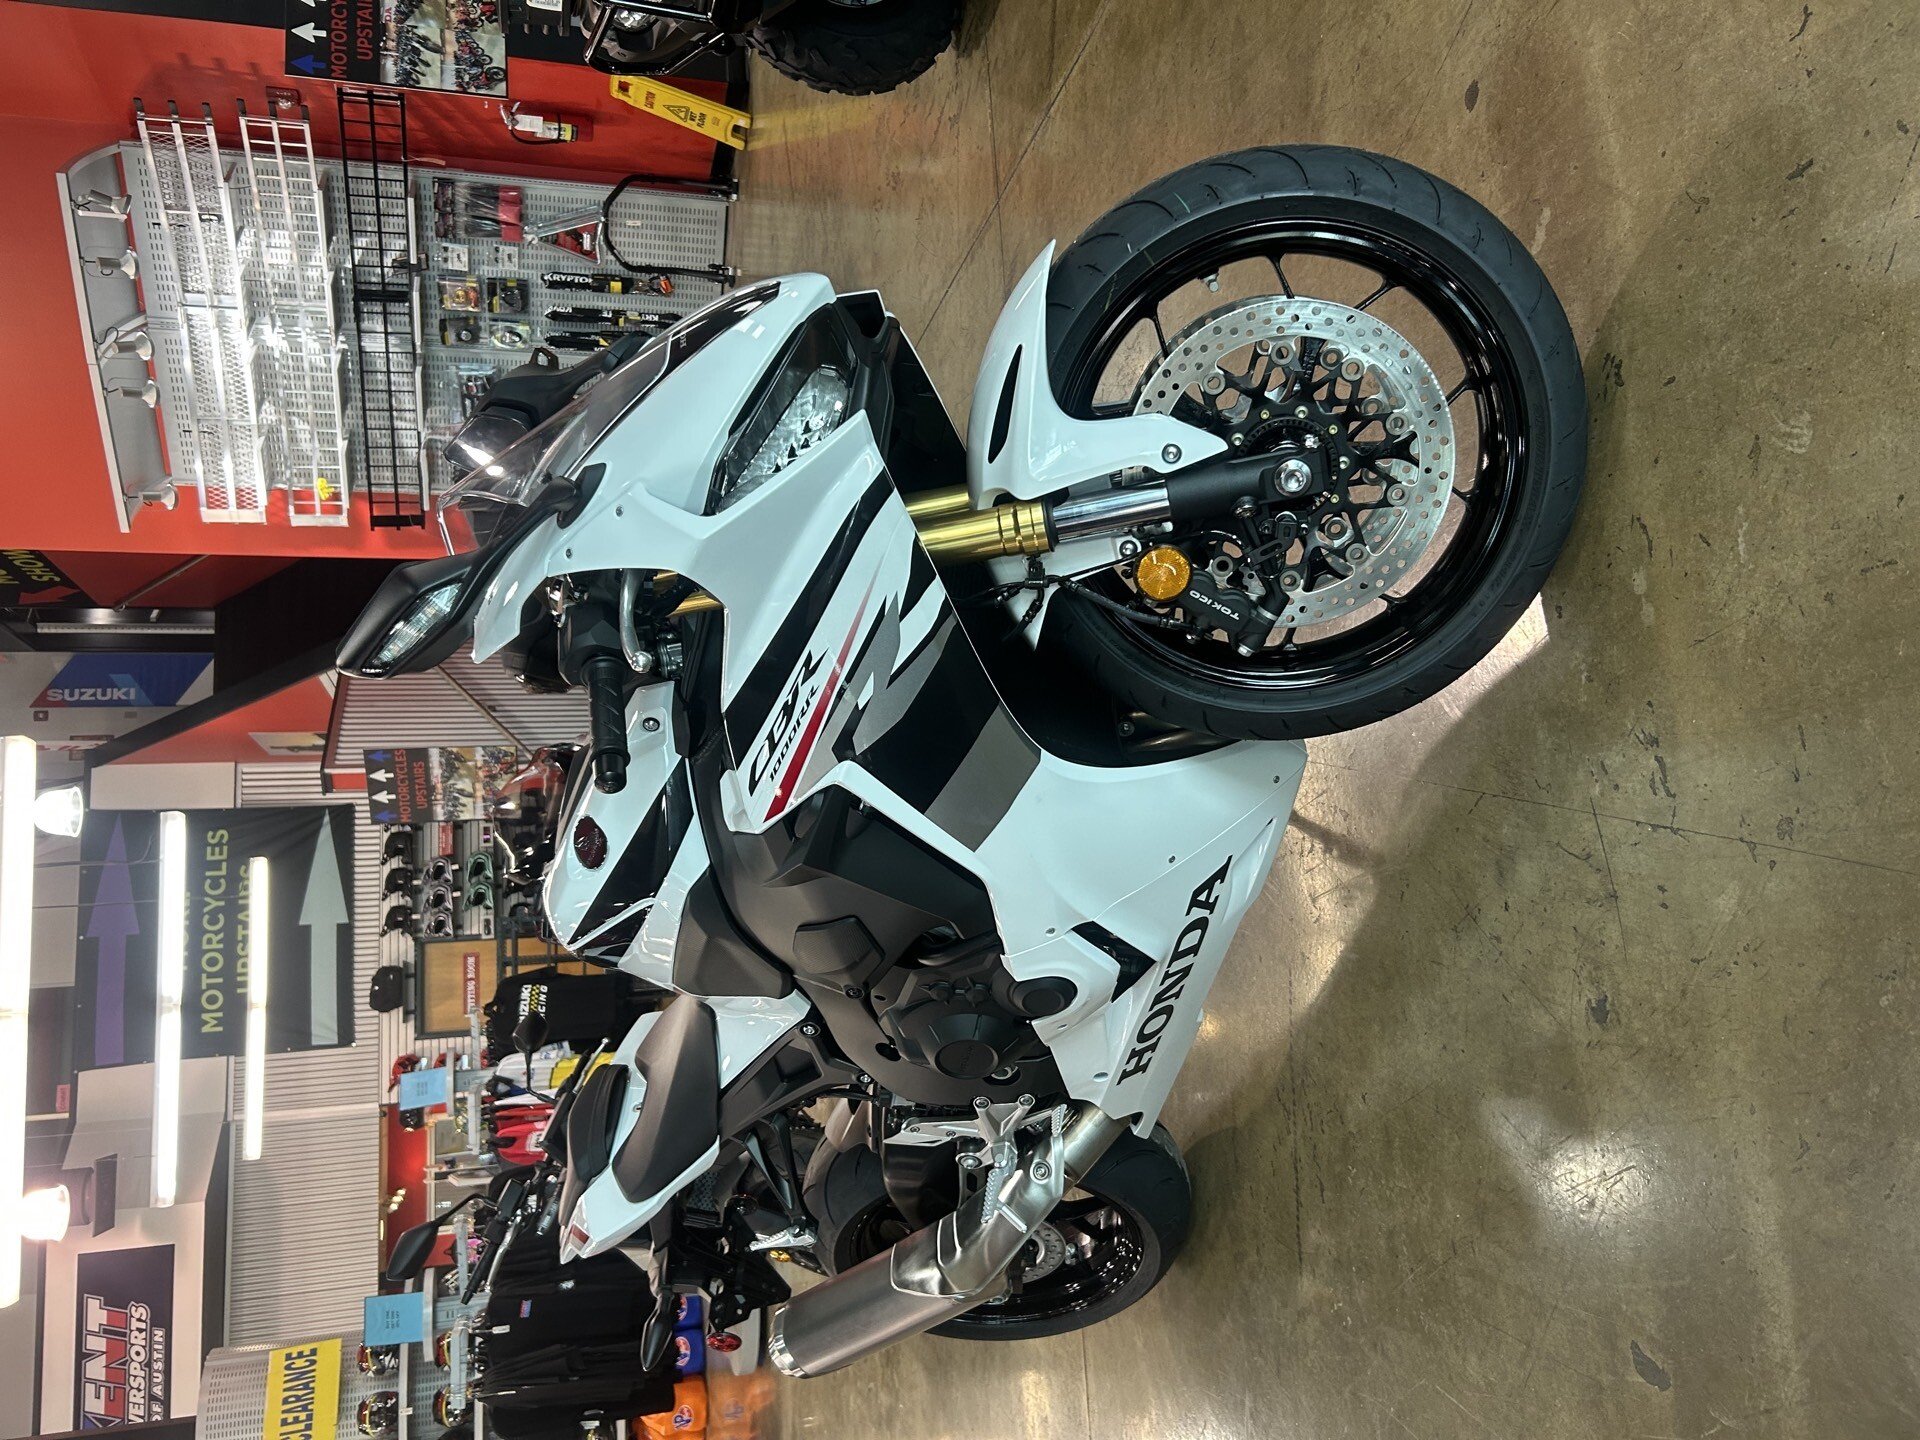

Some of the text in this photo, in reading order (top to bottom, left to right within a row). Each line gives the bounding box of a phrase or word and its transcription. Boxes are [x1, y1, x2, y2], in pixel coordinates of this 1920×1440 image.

[1189, 590, 1240, 620] TOKICO
[46, 687, 136, 702] SUZUKI
[748, 647, 829, 797] CBR
[770, 685, 820, 782] 1000RR
[394, 749, 412, 823] MOTORCYCLES
[414, 761, 428, 809] UPSTAIRS
[201, 829, 229, 1033] MOTORCYCLES
[519, 984, 532, 1023] UZUKI
[1116, 854, 1233, 1086] HONDA
[152, 1330, 164, 1395] AUSTIN
